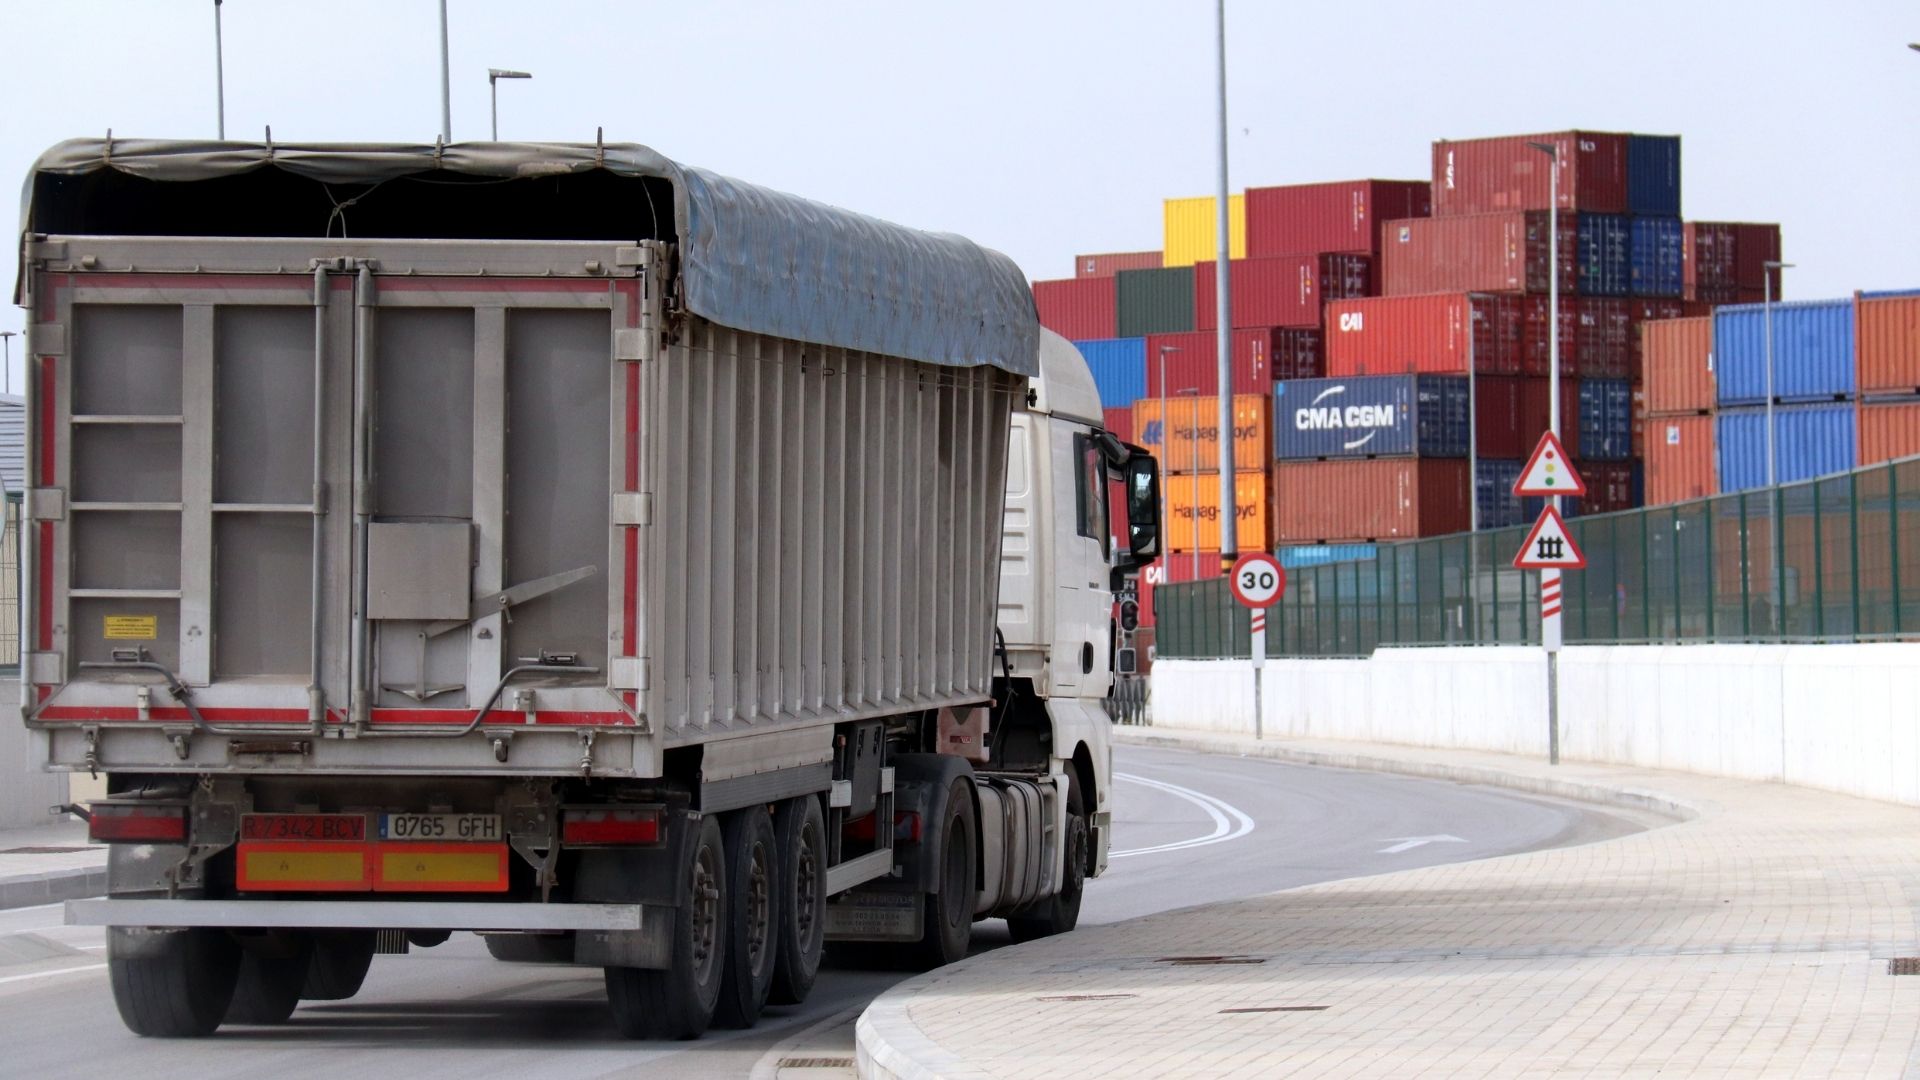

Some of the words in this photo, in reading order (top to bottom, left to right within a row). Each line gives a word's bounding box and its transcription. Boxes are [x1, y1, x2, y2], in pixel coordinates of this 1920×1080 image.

[1340, 312, 1363, 332] CAI
[1296, 406, 1343, 430] CMA
[1345, 404, 1394, 428] CGM
[1174, 422, 1257, 441] Hapag-oyd
[1173, 501, 1257, 520] Hapag-oyd
[1146, 566, 1166, 584] CA
[1242, 571, 1274, 590] 30
[263, 817, 314, 838] 7342
[394, 816, 445, 837] 0765
[458, 816, 496, 837] GFH
